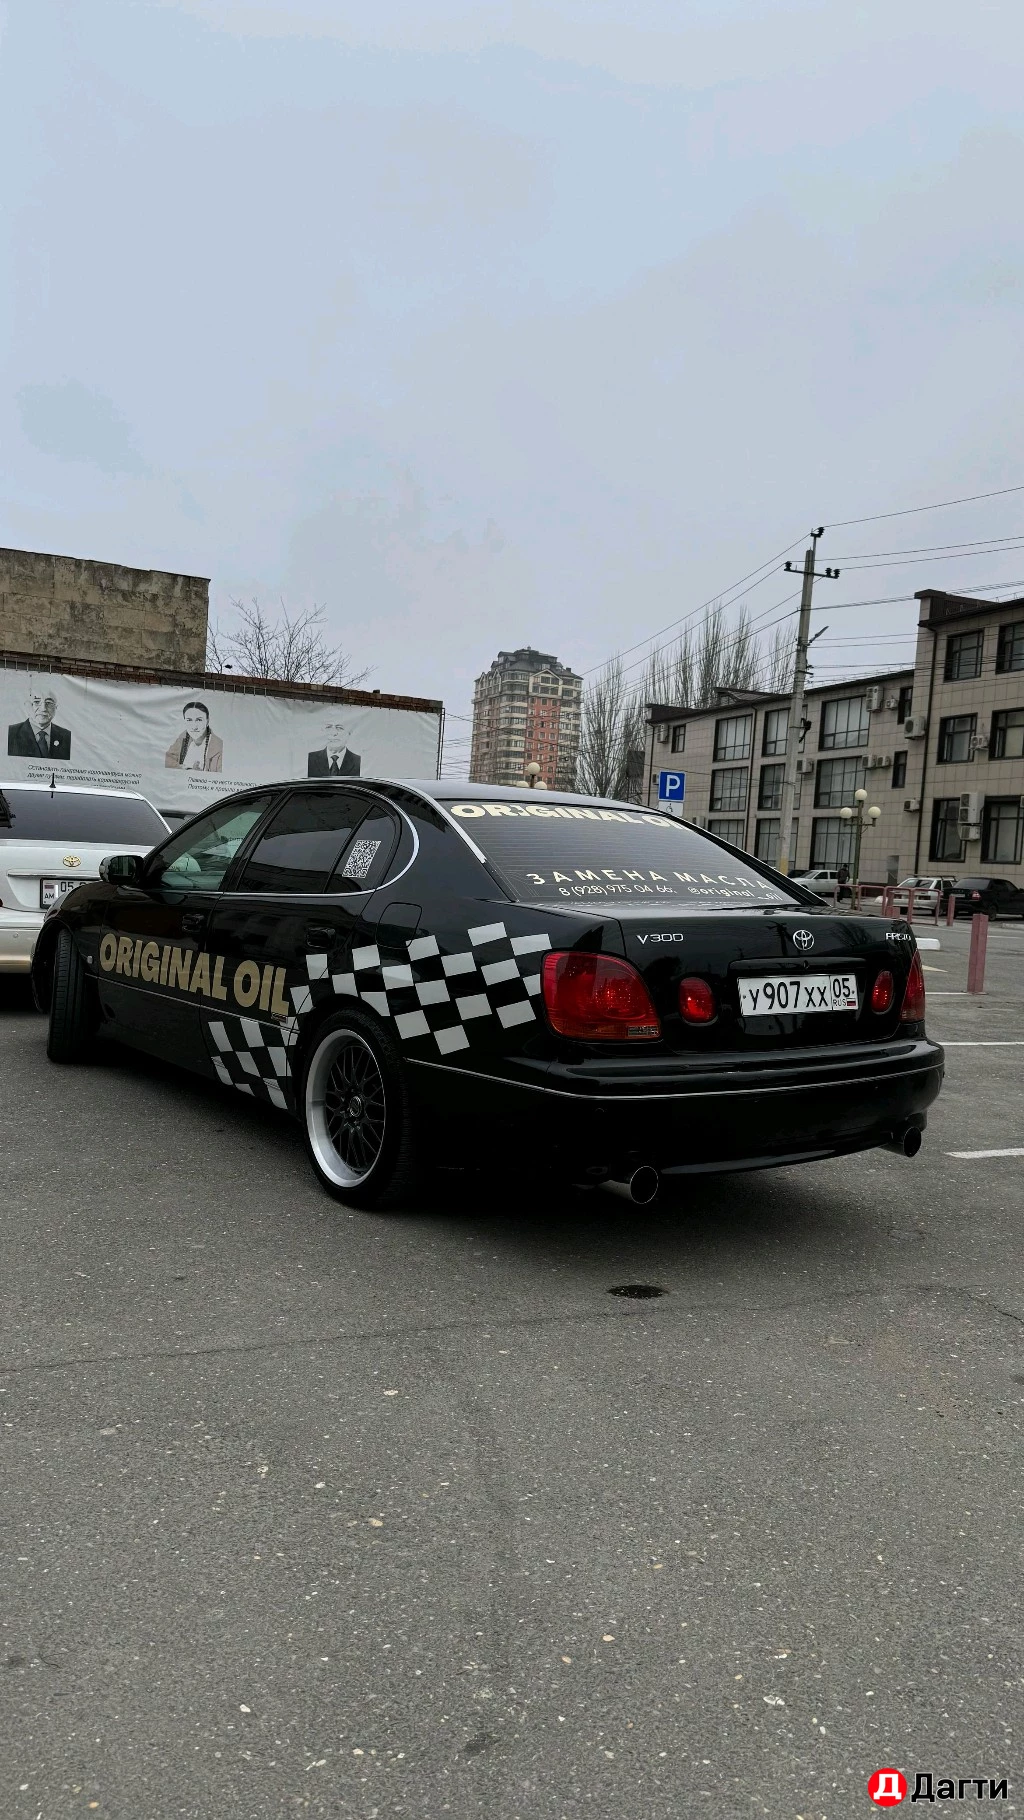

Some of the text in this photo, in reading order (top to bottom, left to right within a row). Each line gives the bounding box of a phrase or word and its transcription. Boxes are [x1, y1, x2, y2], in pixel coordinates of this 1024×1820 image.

[665, 774, 681, 798] P
[450, 804, 645, 825] ORIGINAL
[526, 869, 774, 891] ЗАМЕНА МАСЛА
[558, 887, 571, 896] 8
[571, 885, 608, 897] (928)
[606, 884, 632, 893] 975
[633, 884, 654, 893] 04
[636, 933, 684, 945] V300
[99, 933, 290, 1017] ORIGINAL OIL
[832, 977, 852, 999] 05
[832, 998, 847, 1007] RUS
